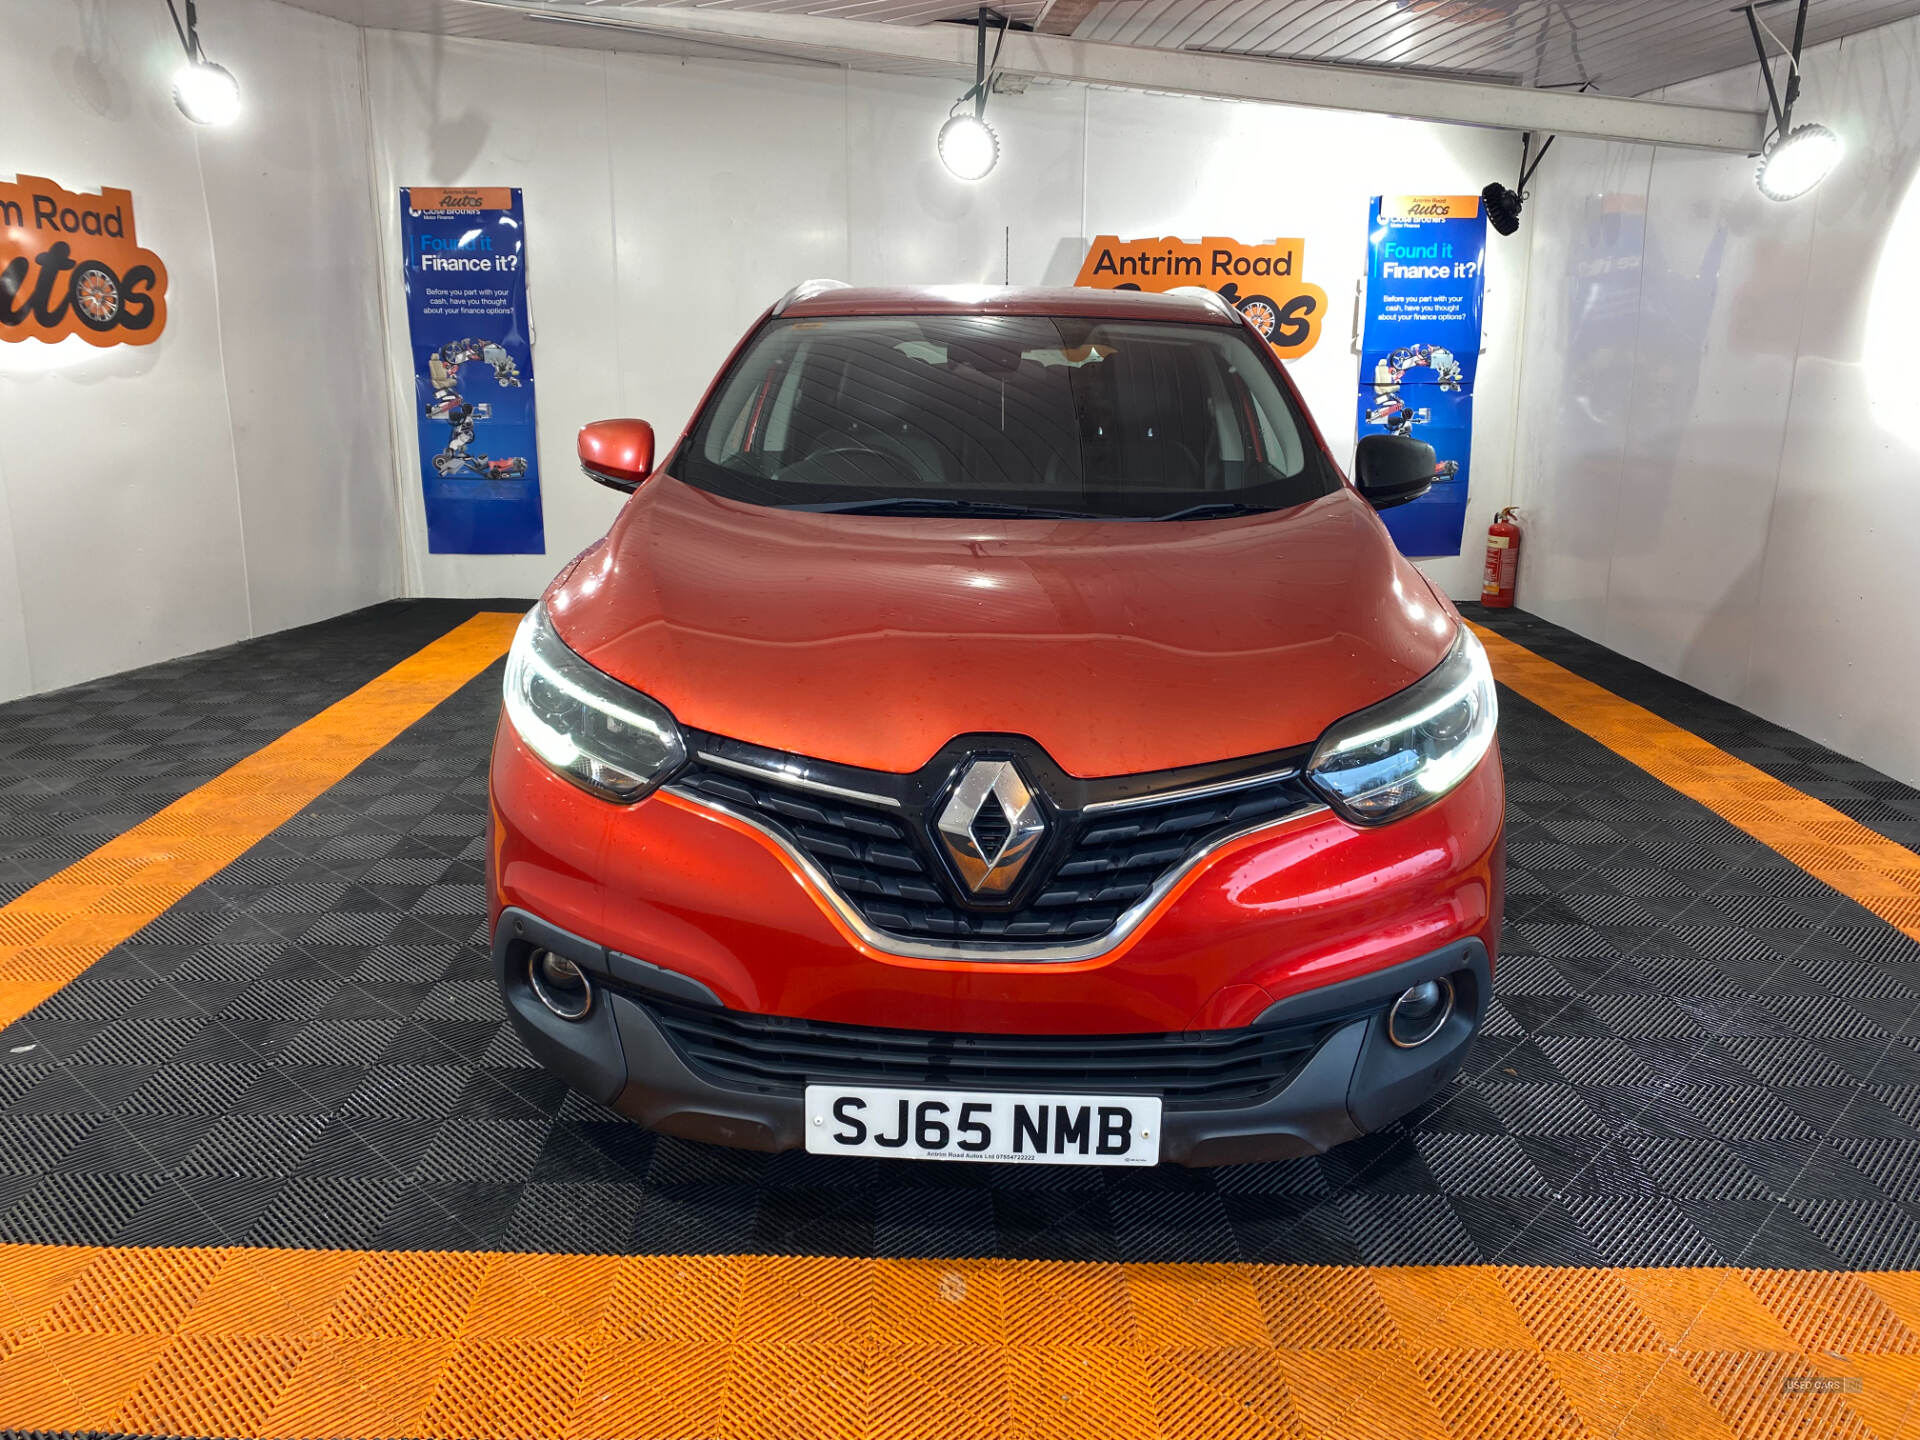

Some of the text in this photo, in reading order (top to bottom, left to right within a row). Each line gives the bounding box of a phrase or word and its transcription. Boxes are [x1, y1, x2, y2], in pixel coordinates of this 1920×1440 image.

[440, 195, 483, 207] Autos
[32, 194, 124, 238] Road
[1408, 204, 1450, 215] Autos
[481, 235, 492, 251] it
[1385, 242, 1453, 258] Found it
[421, 255, 517, 271] Finance it?
[1093, 249, 1292, 276] Antrim Road
[1384, 262, 1476, 279] Finance it?
[450, 289, 462, 297] you
[463, 289, 477, 297] part
[494, 289, 508, 297] your
[1419, 296, 1432, 304] part
[430, 298, 448, 306] cash,
[481, 298, 507, 306] thought
[486, 307, 514, 315] options?
[832, 1096, 1131, 1155] SJ65 NMB
